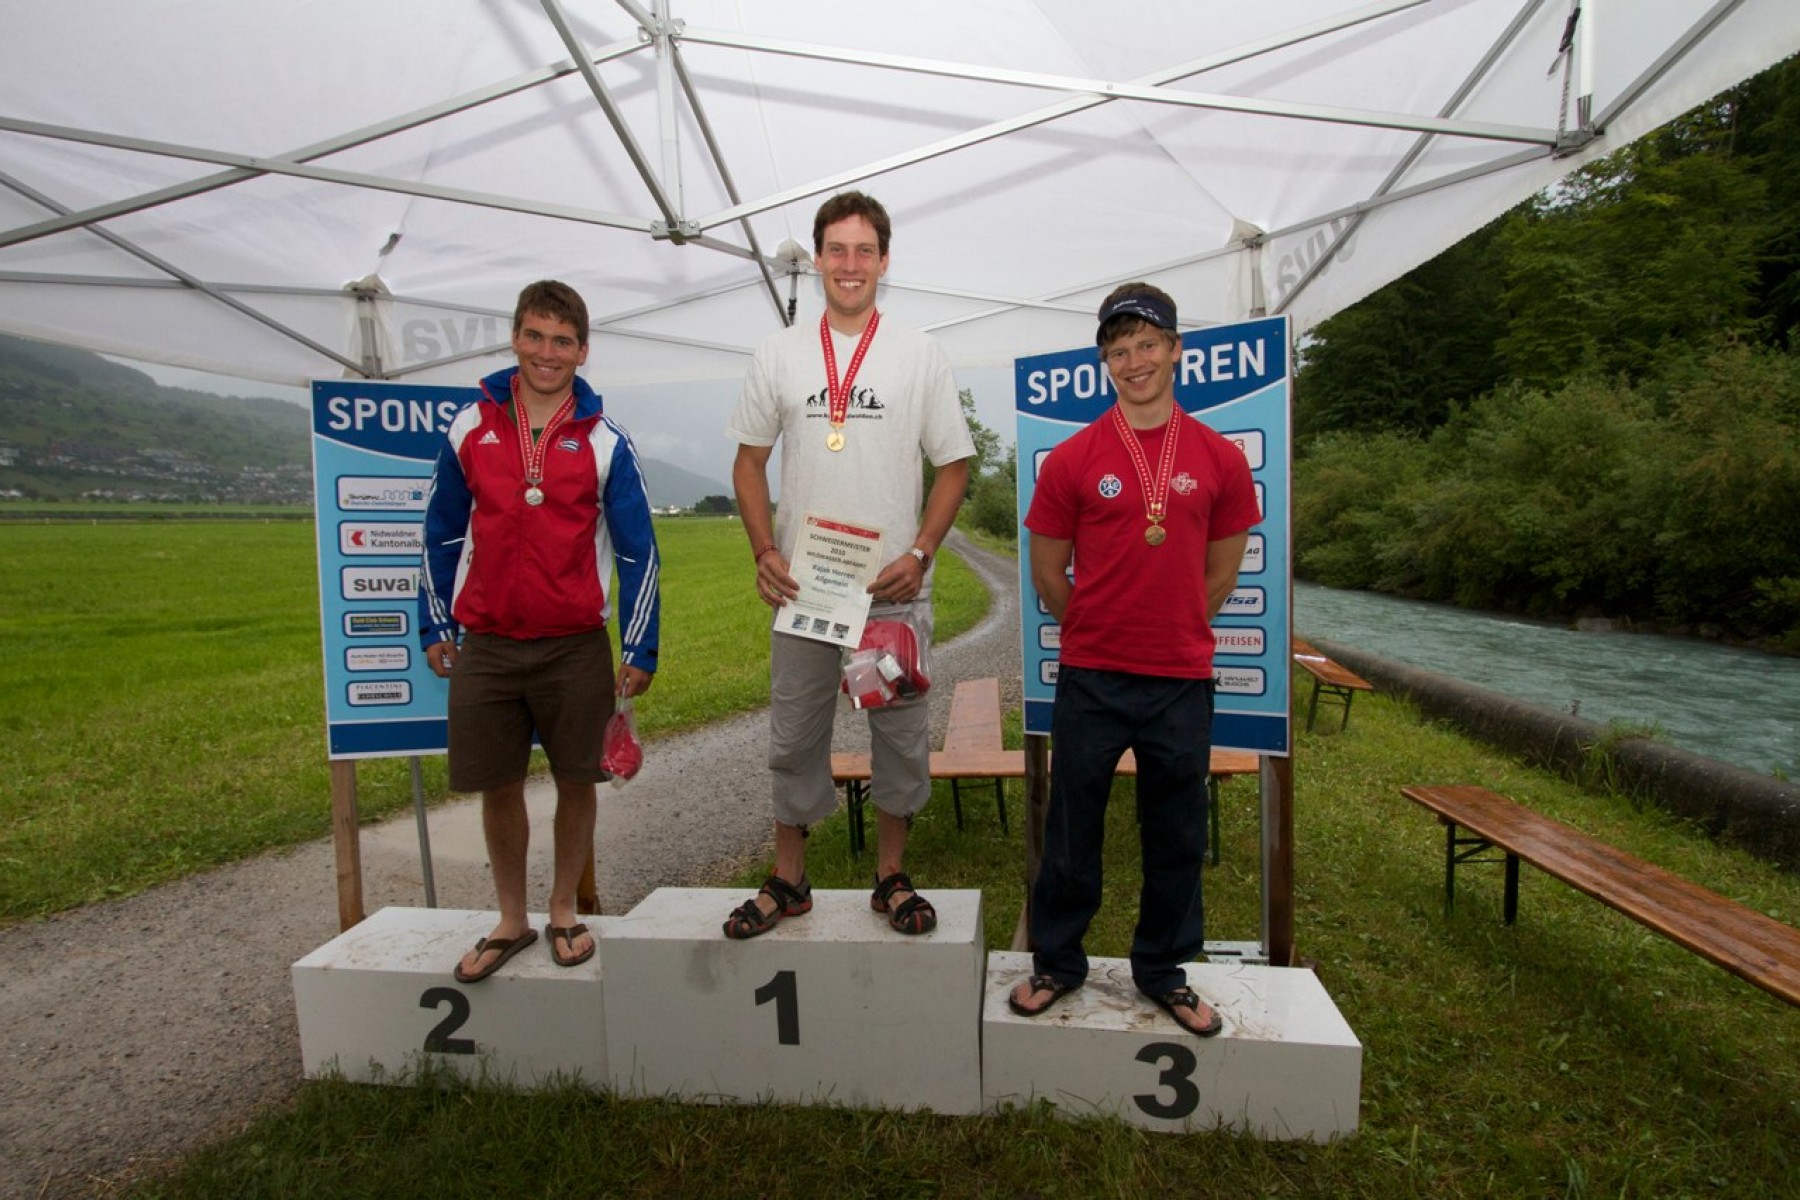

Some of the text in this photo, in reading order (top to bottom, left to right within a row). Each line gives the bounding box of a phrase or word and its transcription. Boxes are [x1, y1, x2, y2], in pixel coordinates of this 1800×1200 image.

[1027, 338, 1266, 405] SPONREN
[370, 530, 417, 538] Nidwaldner
[419, 987, 476, 1055] 2
[755, 970, 800, 1045] 1
[1132, 1042, 1200, 1119] 3
